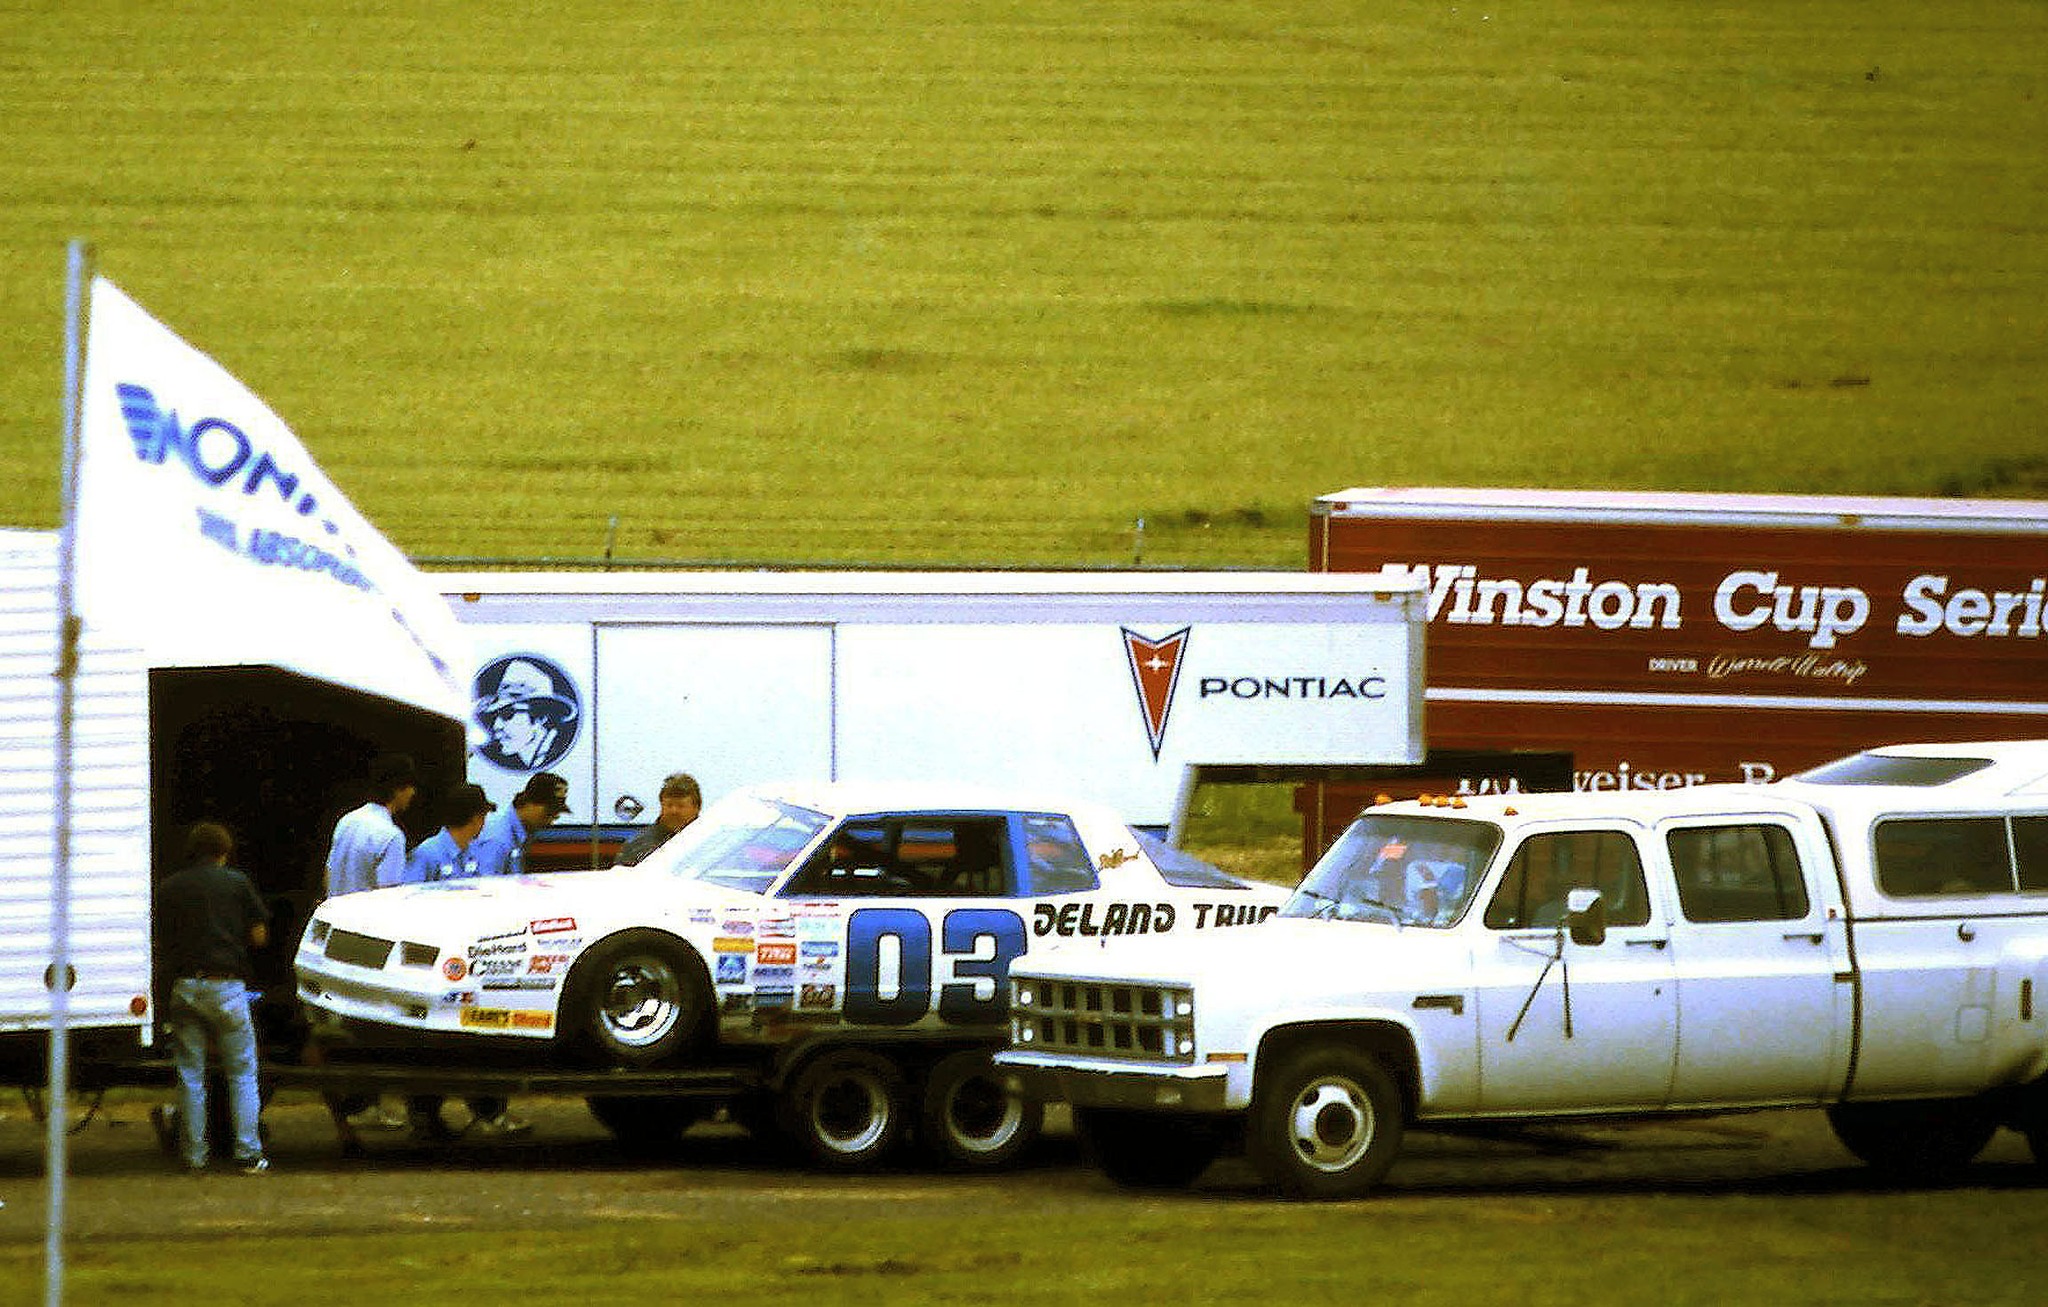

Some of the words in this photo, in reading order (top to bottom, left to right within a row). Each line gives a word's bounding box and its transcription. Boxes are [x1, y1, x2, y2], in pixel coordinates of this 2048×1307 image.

[1712, 571, 1870, 649] Cup
[1896, 574, 2048, 638] Seri
[1200, 677, 1387, 699] PONTIAC
[1033, 902, 1176, 937] DELAND
[846, 908, 1028, 1026] 03
